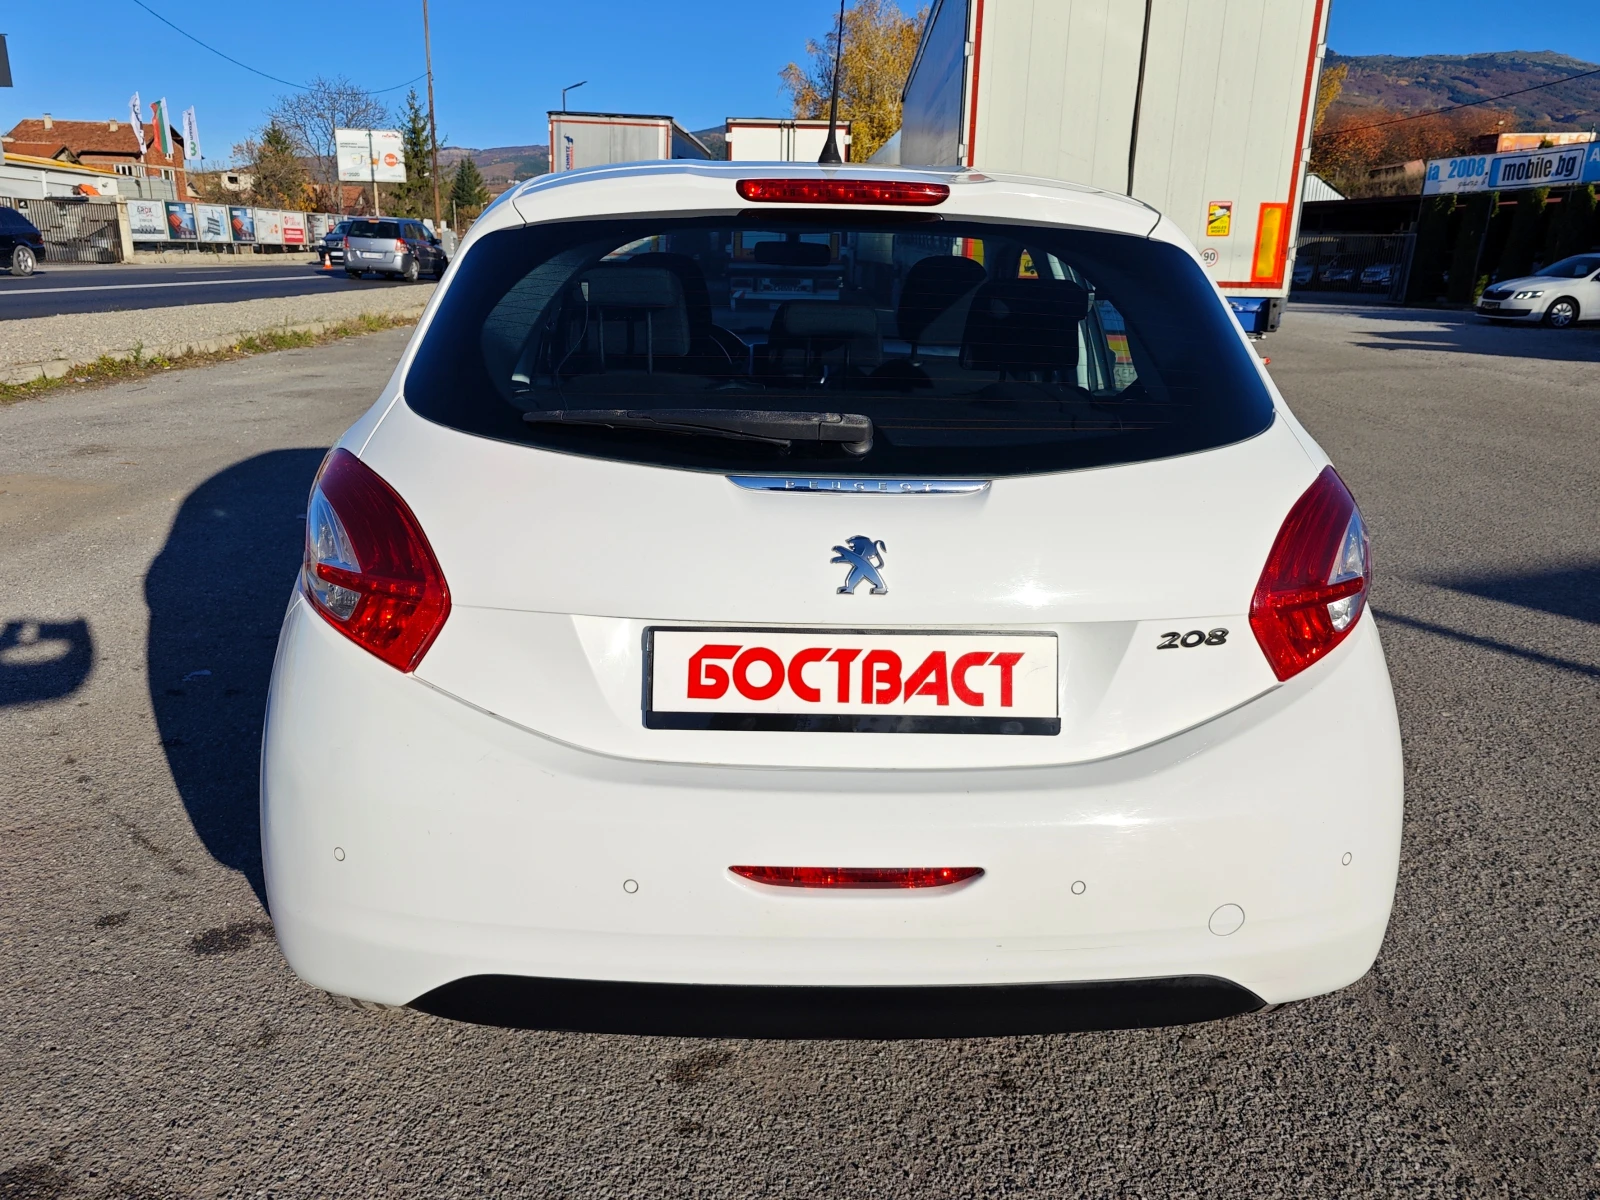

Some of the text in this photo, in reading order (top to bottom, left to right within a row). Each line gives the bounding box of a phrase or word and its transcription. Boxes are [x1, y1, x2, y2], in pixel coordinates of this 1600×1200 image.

[1502, 155, 1577, 181] mobile.bg
[1203, 252, 1216, 261] 90
[785, 480, 933, 491] PEUGEOT
[1156, 627, 1229, 650] 208
[687, 644, 1025, 707] БОСТВАСТ
